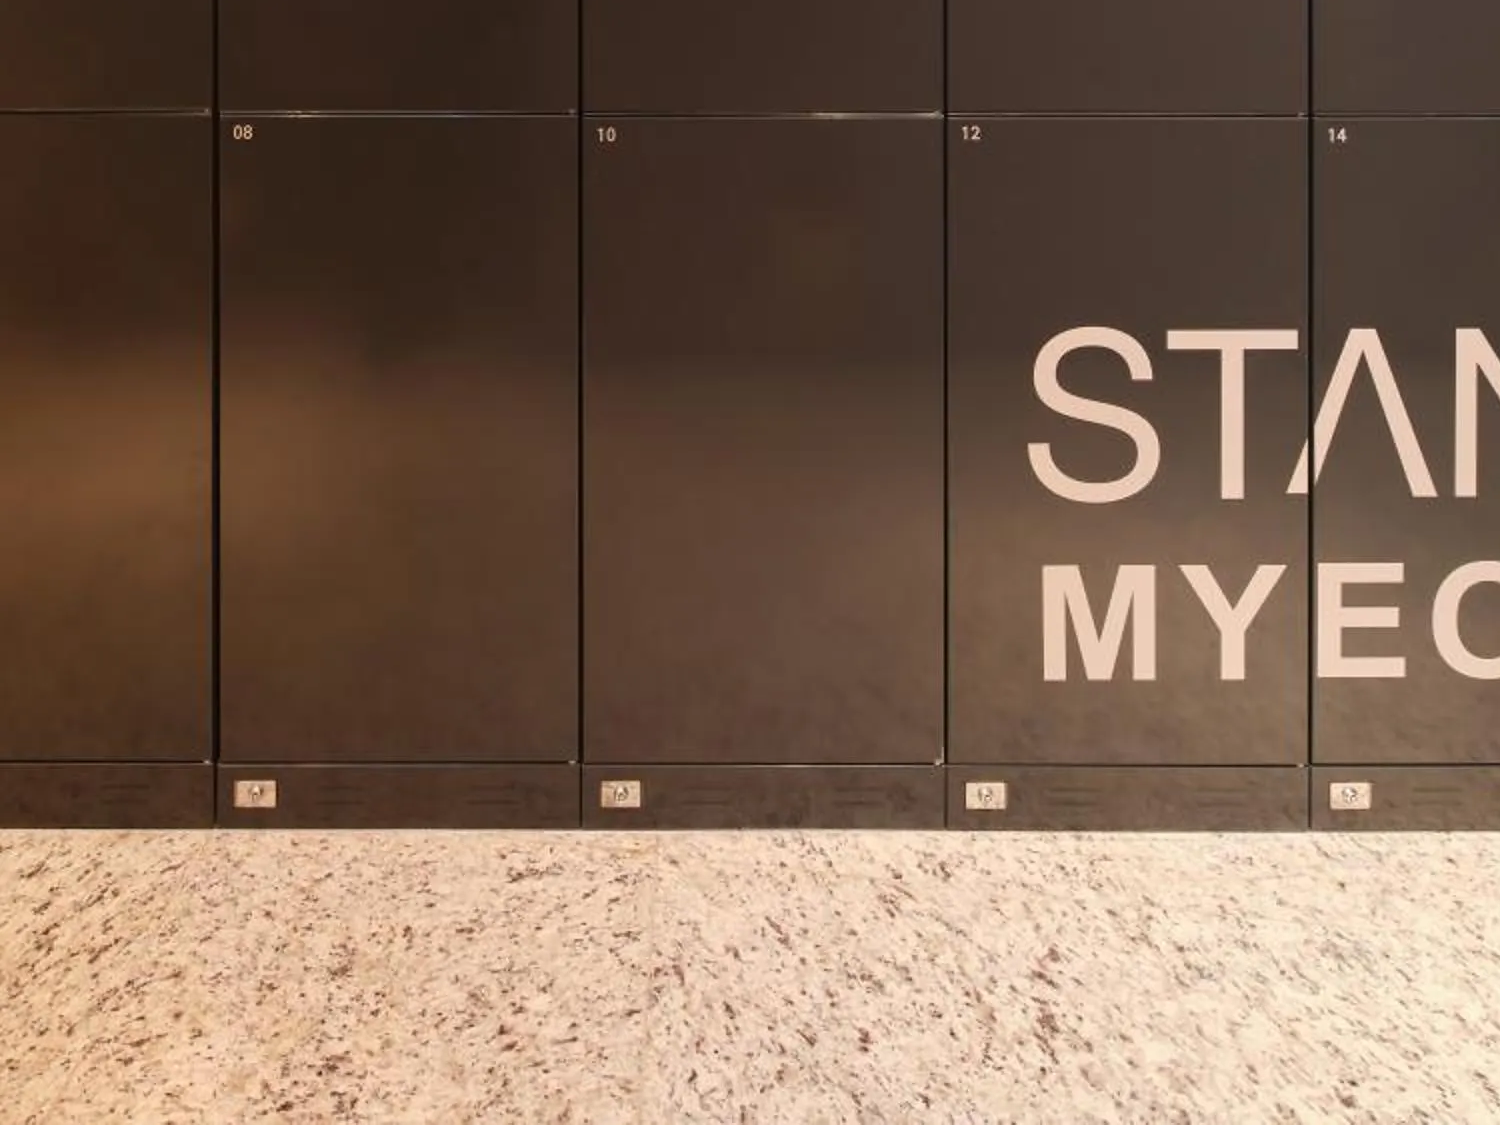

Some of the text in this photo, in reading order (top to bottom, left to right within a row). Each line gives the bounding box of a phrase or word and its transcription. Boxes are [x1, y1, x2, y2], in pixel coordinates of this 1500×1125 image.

[233, 124, 253, 140] 08
[597, 126, 617, 142] 10
[961, 125, 981, 140] 12
[1328, 127, 1347, 143] 14
